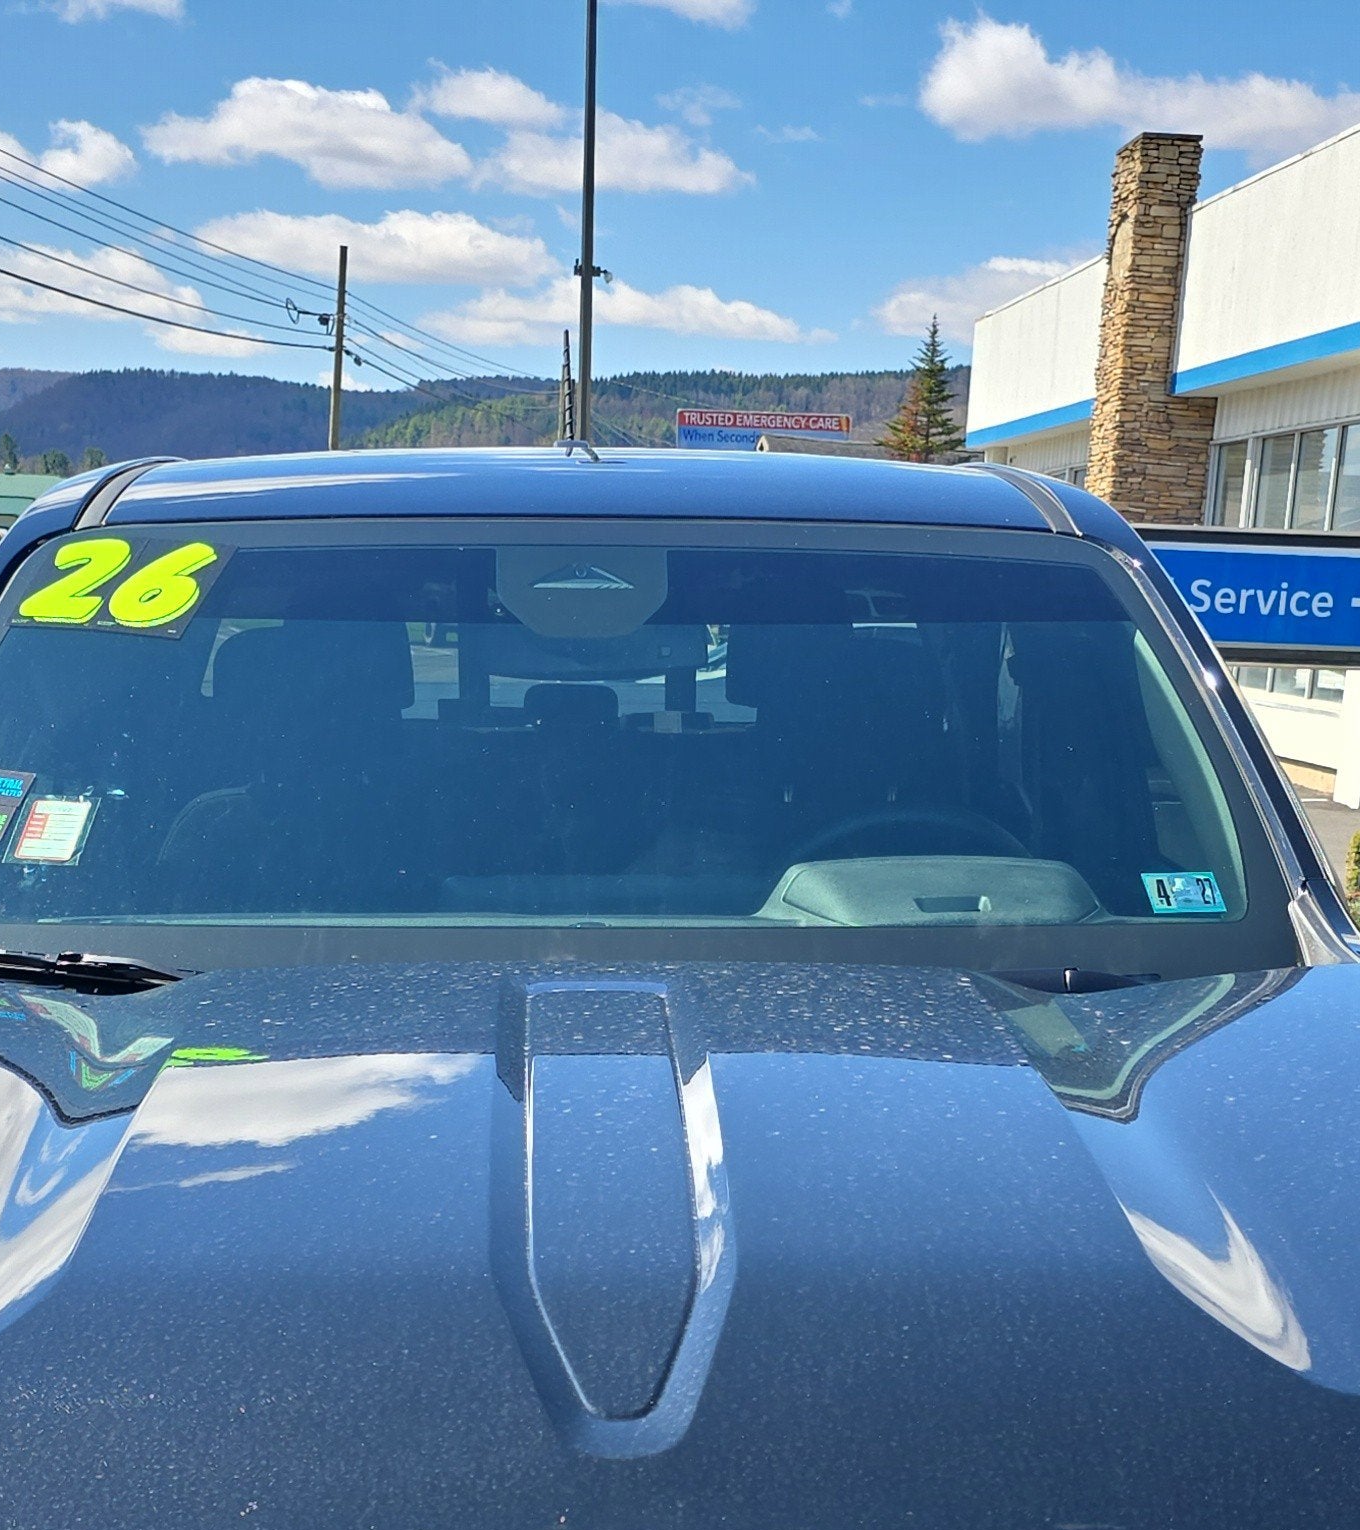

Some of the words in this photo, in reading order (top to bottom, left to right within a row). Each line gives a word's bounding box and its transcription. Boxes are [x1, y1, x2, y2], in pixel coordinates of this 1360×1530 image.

[682, 429, 715, 442] When
[683, 412, 733, 425] TRUSTED
[736, 414, 809, 429] EMERGENCY
[810, 416, 840, 430] CARE
[19, 538, 218, 628] 26
[1190, 579, 1334, 617] Service
[1156, 879, 1172, 906] 4
[1195, 877, 1217, 906] 27
